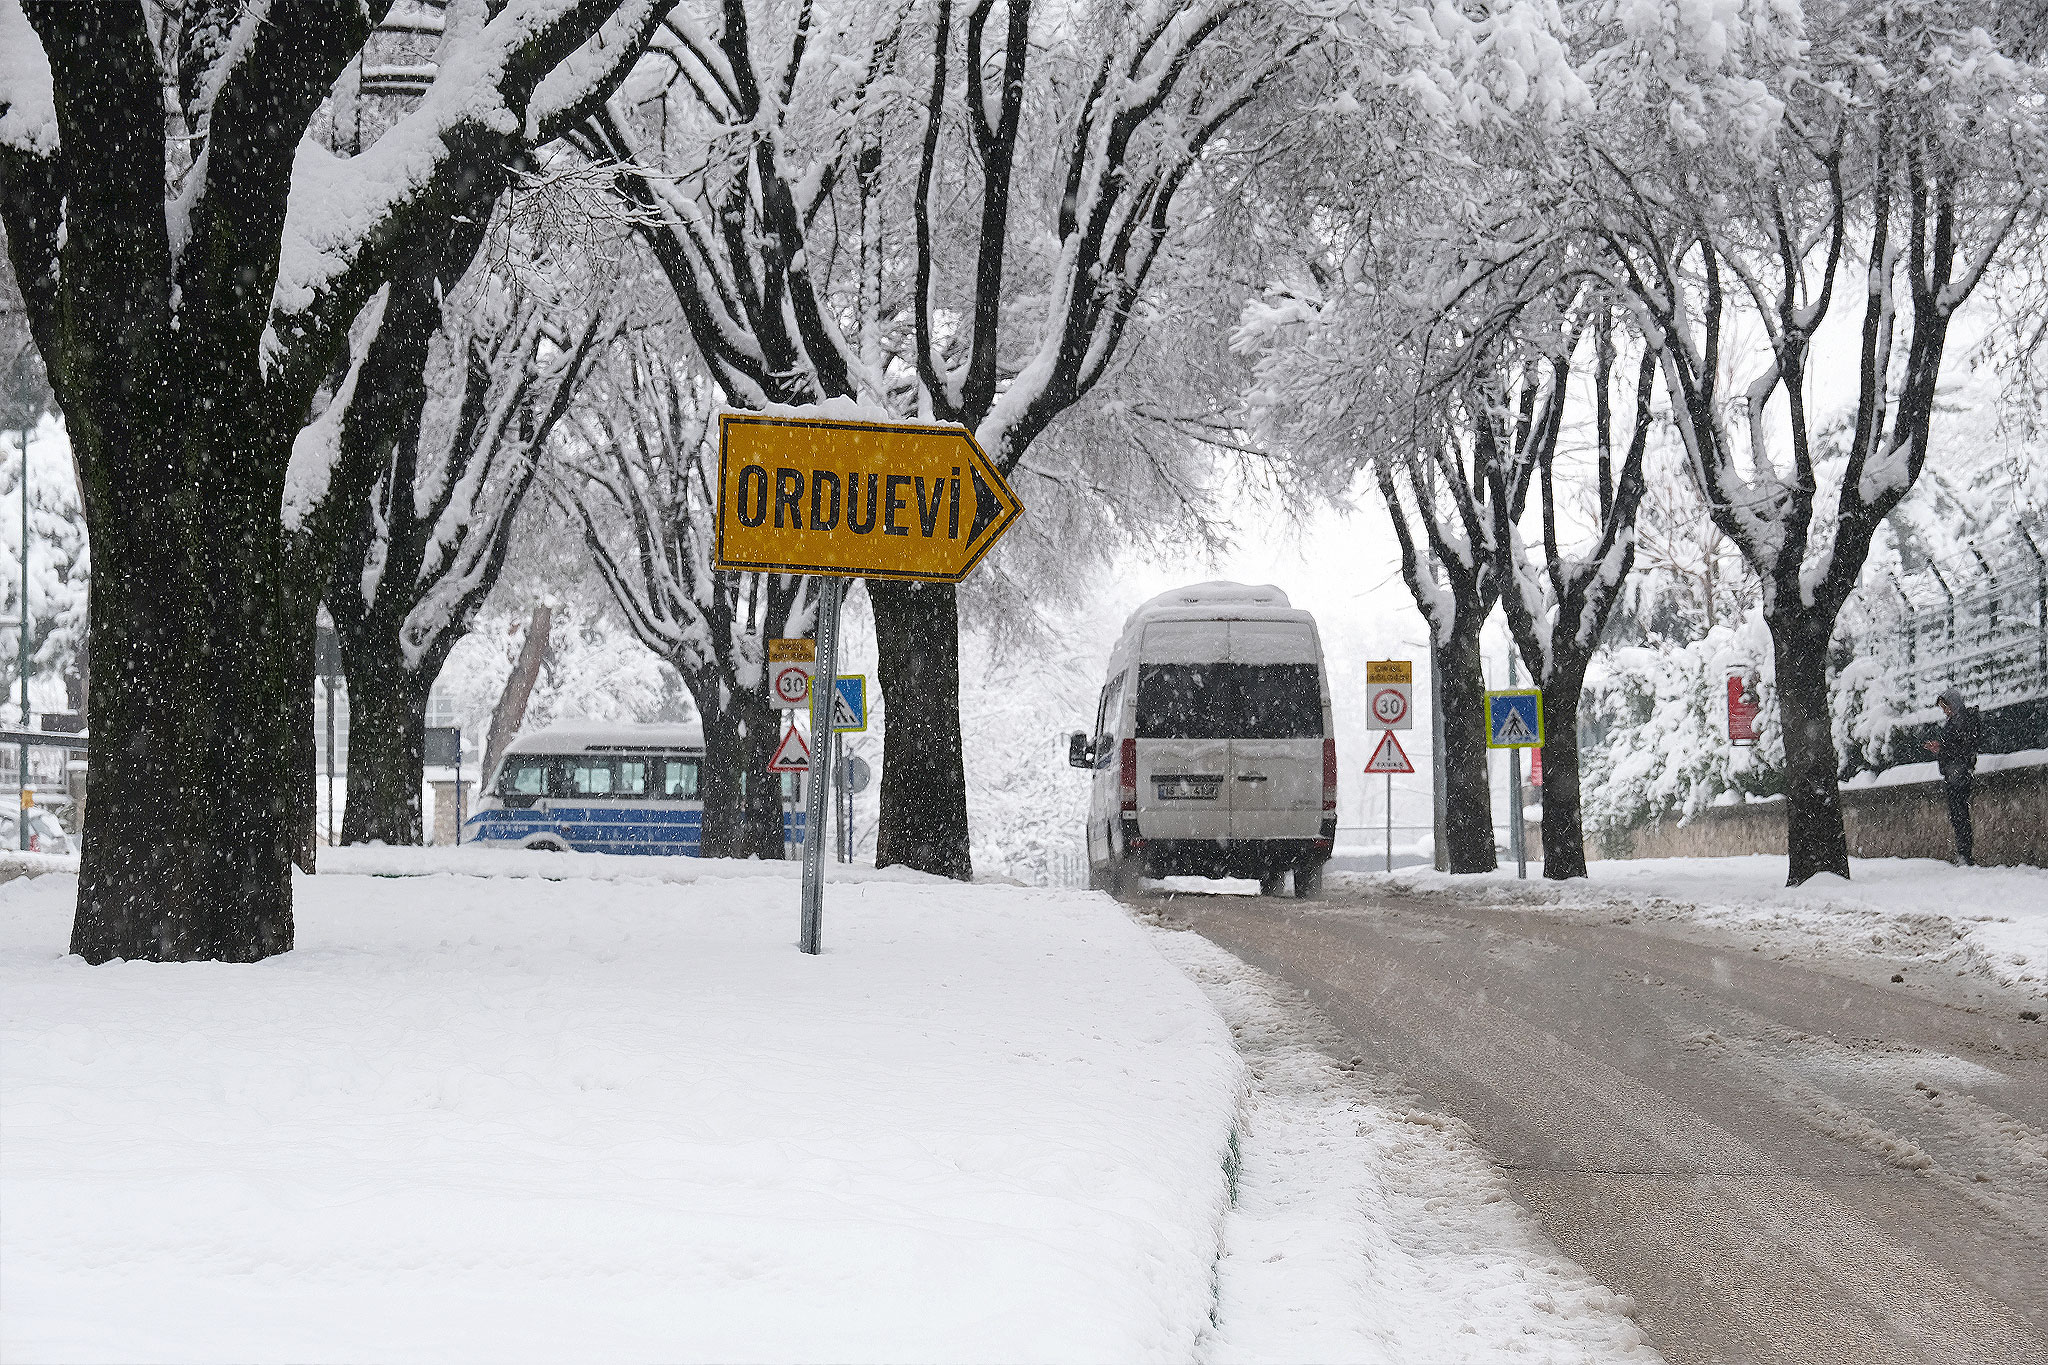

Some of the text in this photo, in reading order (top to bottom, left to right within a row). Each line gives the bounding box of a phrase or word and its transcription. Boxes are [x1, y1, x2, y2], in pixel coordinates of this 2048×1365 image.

[736, 464, 961, 540] ORDUEVİ
[782, 677, 804, 692] 30
[1380, 698, 1399, 715] 30
